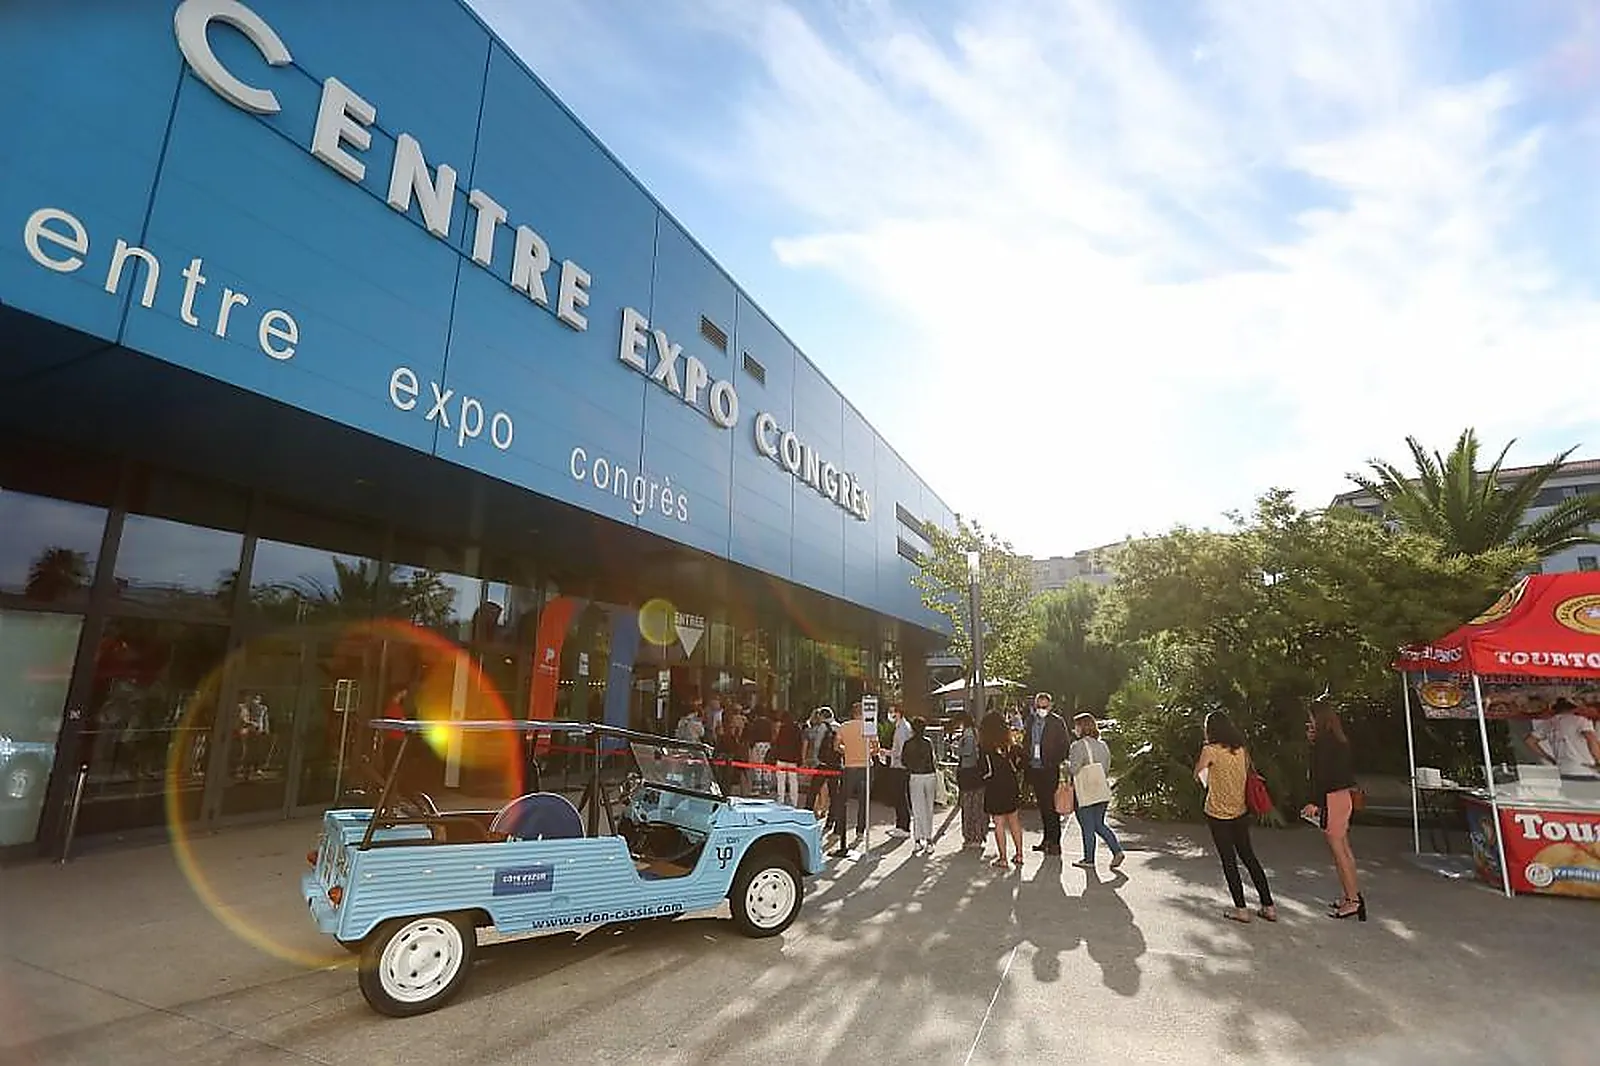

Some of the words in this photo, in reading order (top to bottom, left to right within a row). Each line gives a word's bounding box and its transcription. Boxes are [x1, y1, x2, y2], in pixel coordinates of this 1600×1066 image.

[23, 207, 300, 362] entre
[388, 365, 515, 449] expo
[568, 446, 690, 523] congrès
[174, 0, 593, 333] CENTRE
[619, 306, 739, 429] EXPO
[753, 410, 871, 523] CONGRÈS
